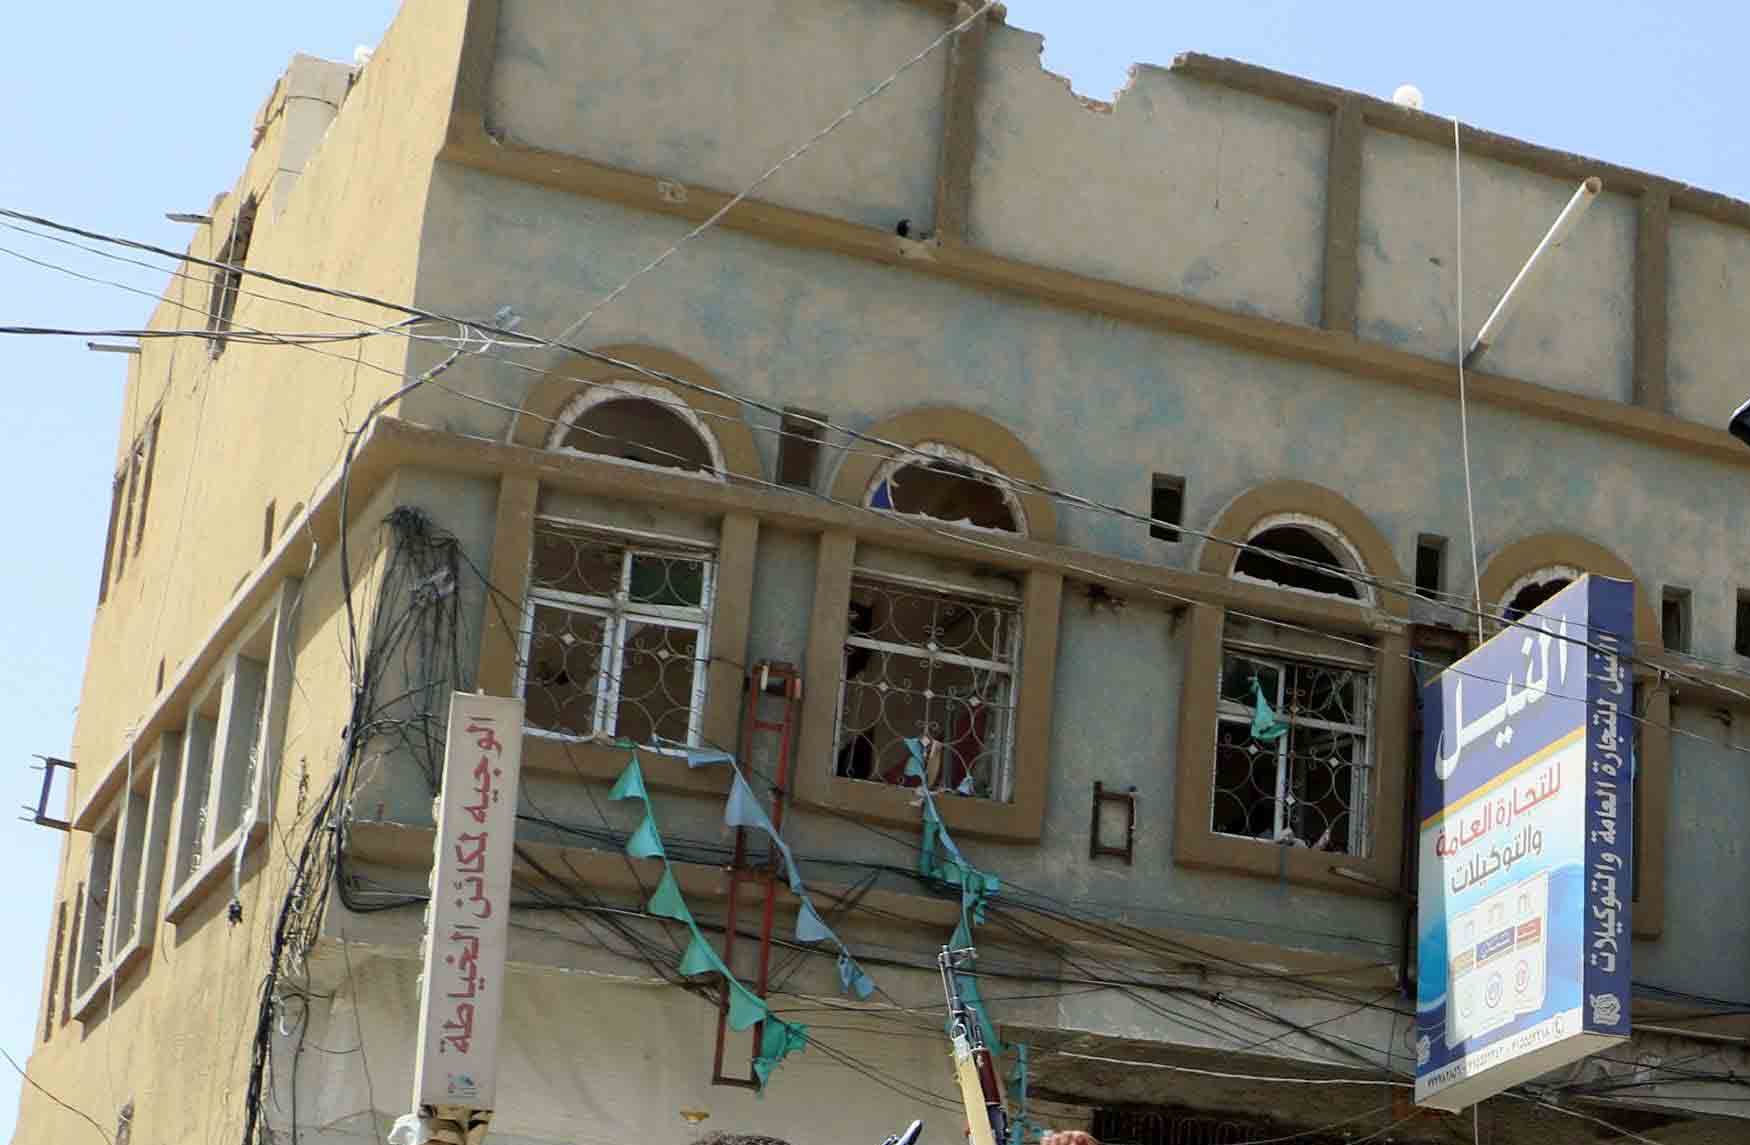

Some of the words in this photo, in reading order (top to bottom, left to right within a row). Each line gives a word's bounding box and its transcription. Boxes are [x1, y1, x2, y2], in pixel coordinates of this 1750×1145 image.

[1434, 612, 1568, 780] النيل
[1590, 634, 1624, 694] النيل
[463, 715, 503, 824] الوجيه
[1593, 698, 1623, 776] للتجارة
[1435, 800, 1493, 857] العامة
[1495, 761, 1561, 827] للتجارة
[1591, 780, 1617, 844] العامة
[1451, 824, 1543, 894] والتوكيلات
[1591, 852, 1623, 972] والتوكيلات
[439, 924, 486, 1055] الخياطة
